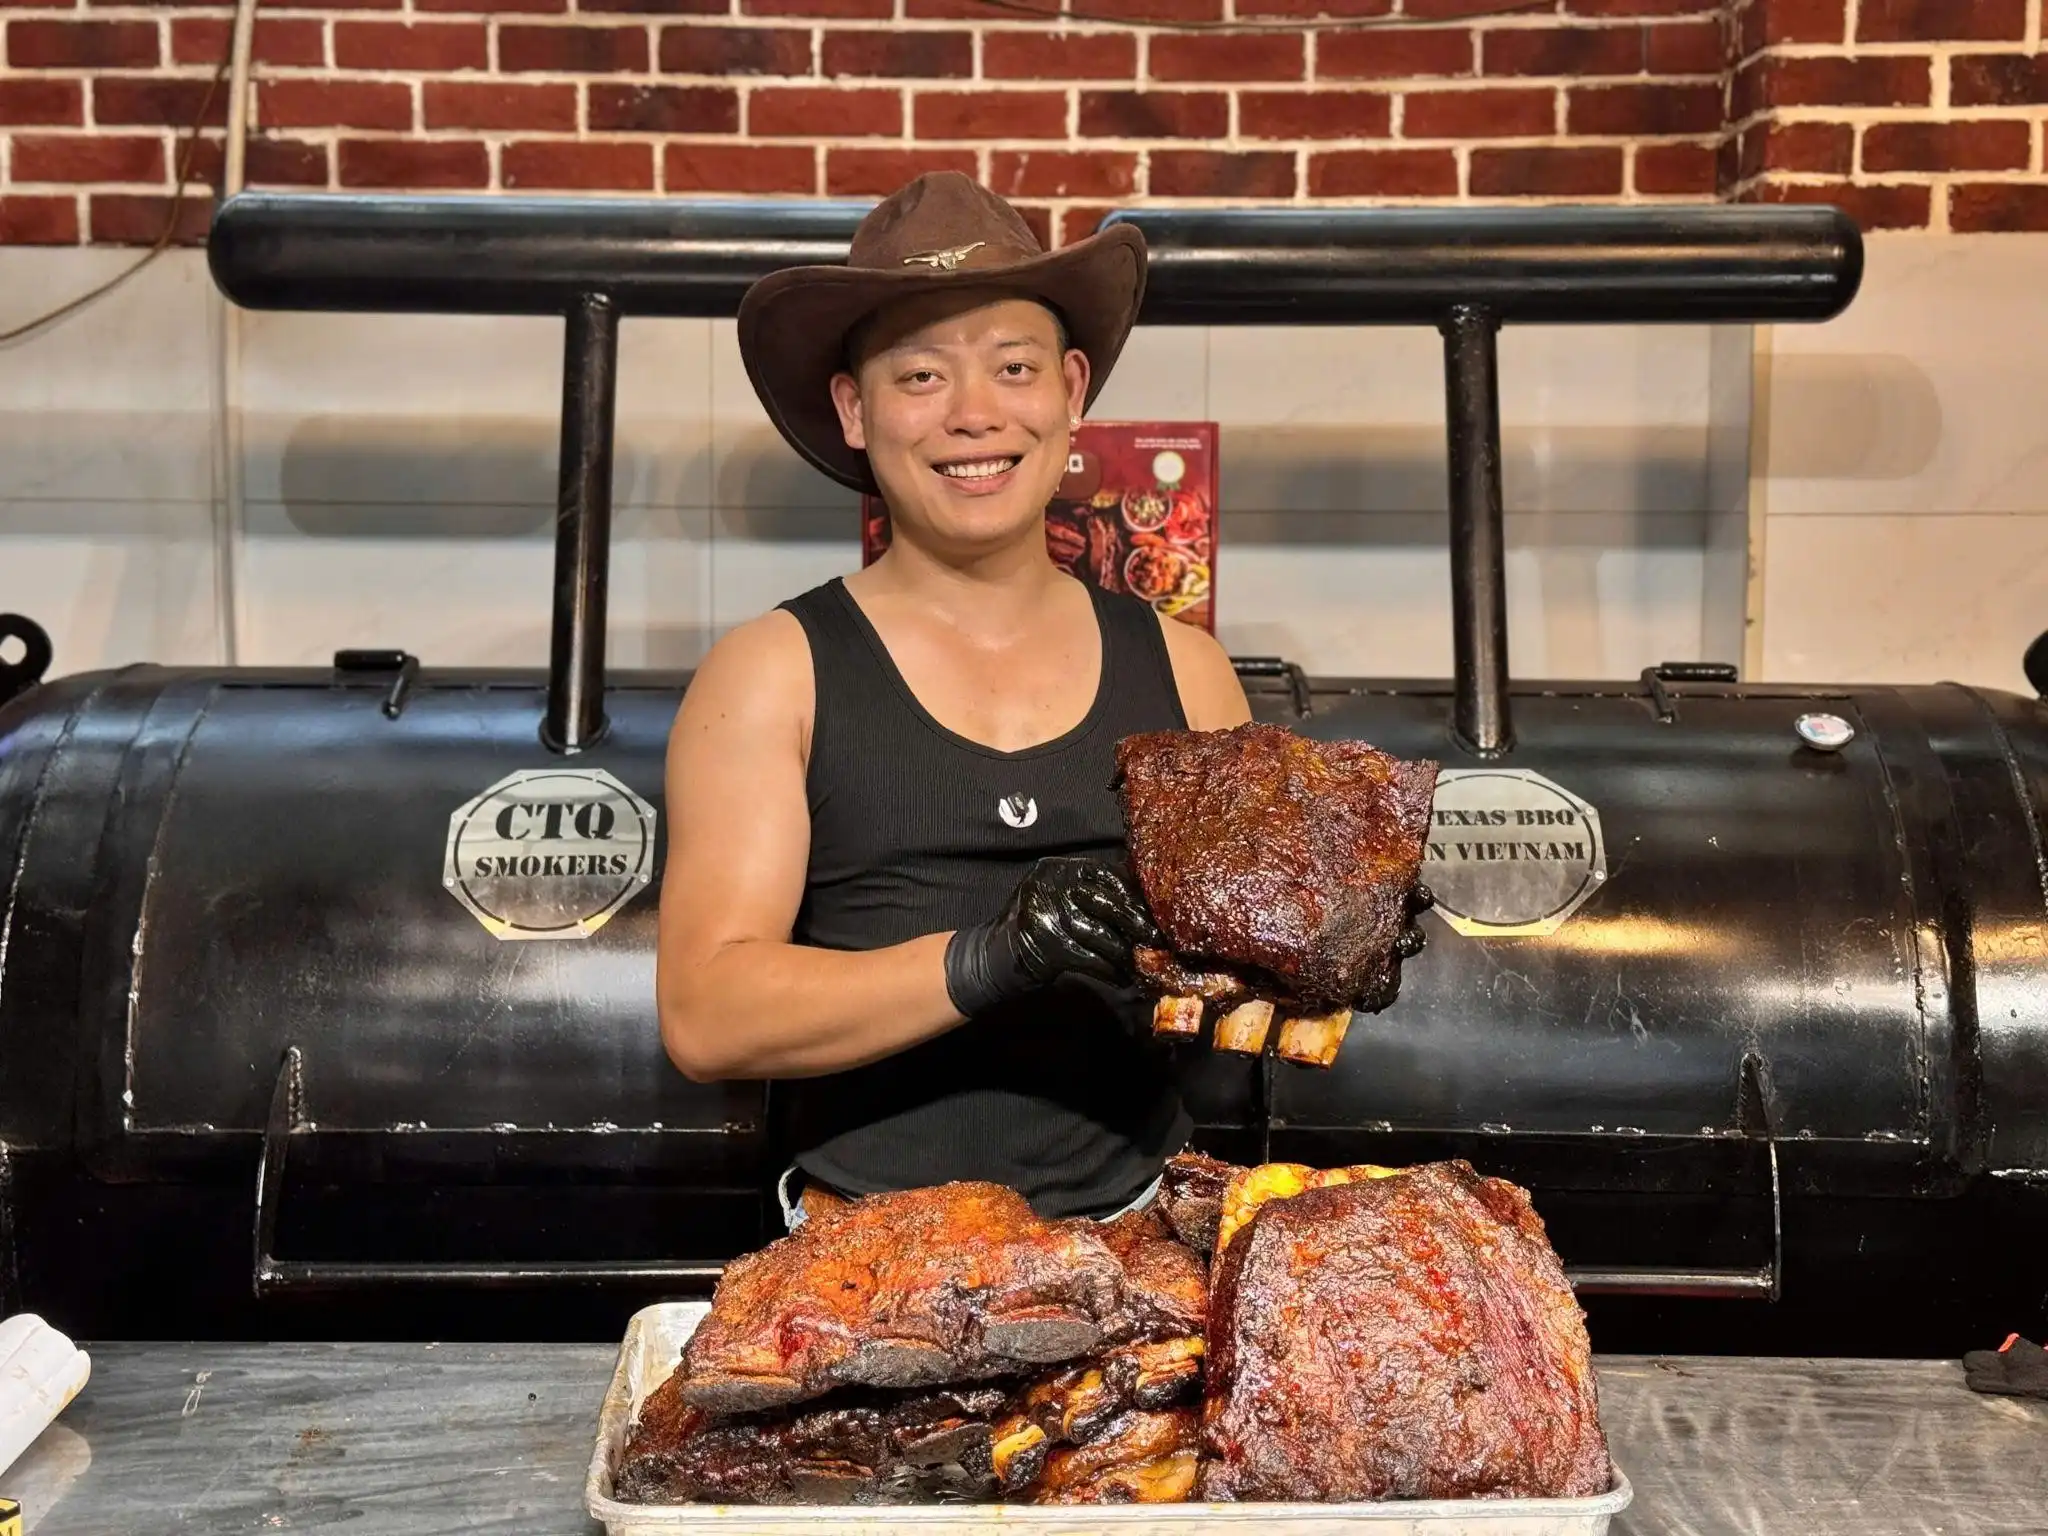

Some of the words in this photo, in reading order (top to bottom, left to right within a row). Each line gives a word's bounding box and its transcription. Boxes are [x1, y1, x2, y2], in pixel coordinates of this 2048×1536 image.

[495, 801, 615, 840] CTQ
[1514, 808, 1577, 827] BBQ
[1424, 842, 1447, 861] N
[1455, 841, 1586, 861] VIETNAM
[474, 854, 628, 878] SMOKERS
